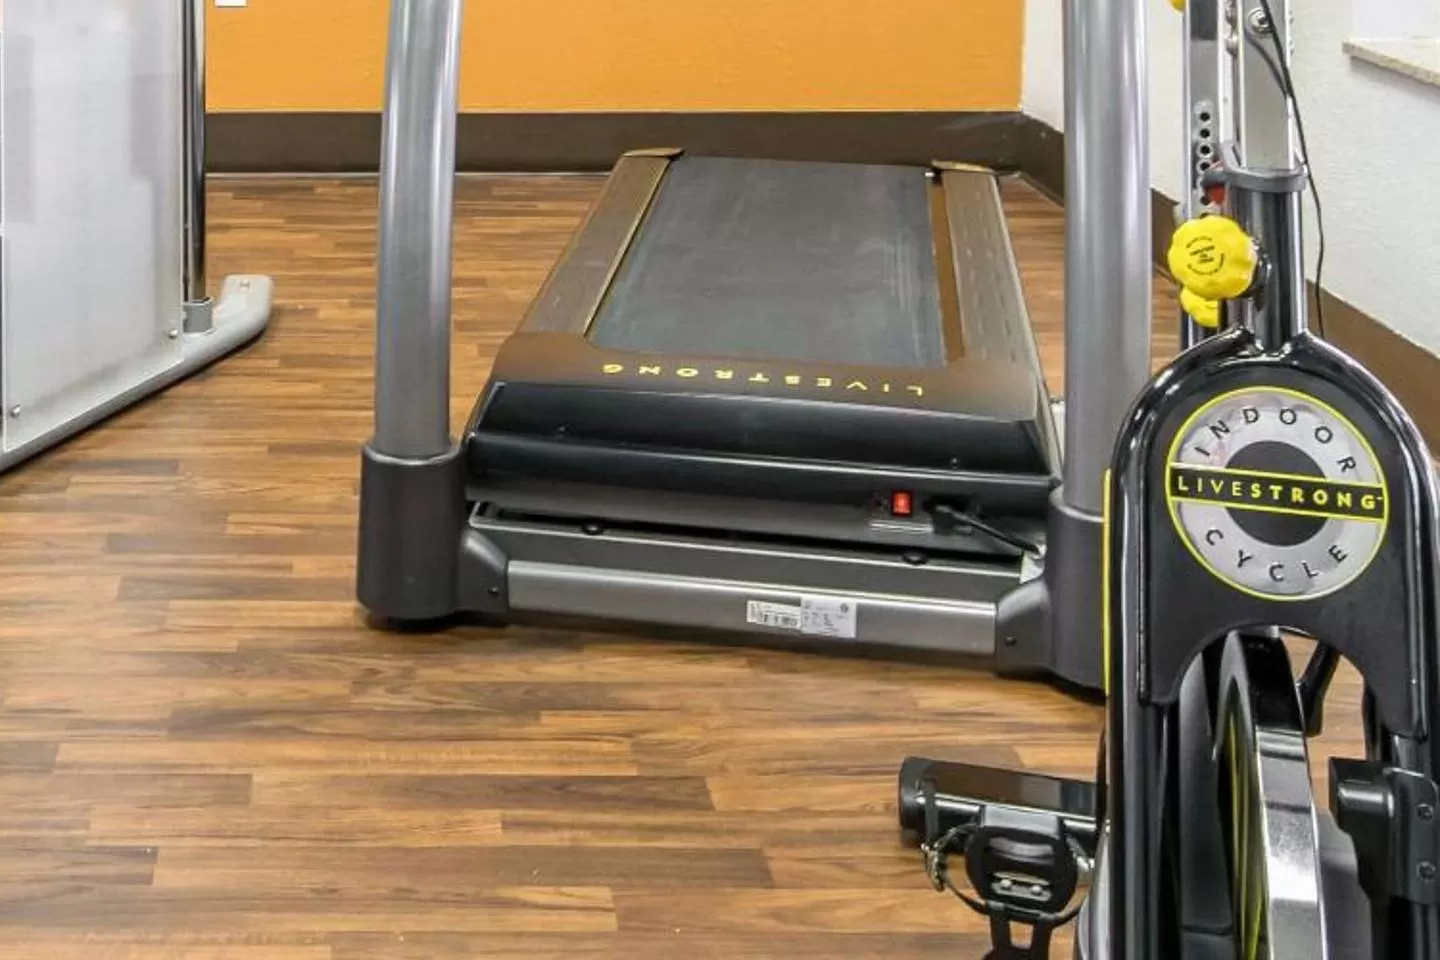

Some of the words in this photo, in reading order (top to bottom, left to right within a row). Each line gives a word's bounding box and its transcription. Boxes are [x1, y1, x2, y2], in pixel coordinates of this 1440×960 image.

[602, 364, 923, 397] LIVESTRONG
[1193, 407, 1357, 473] INDOOR
[1177, 475, 1377, 508] LIVESTRONG
[1205, 528, 1348, 582] CYCLE
